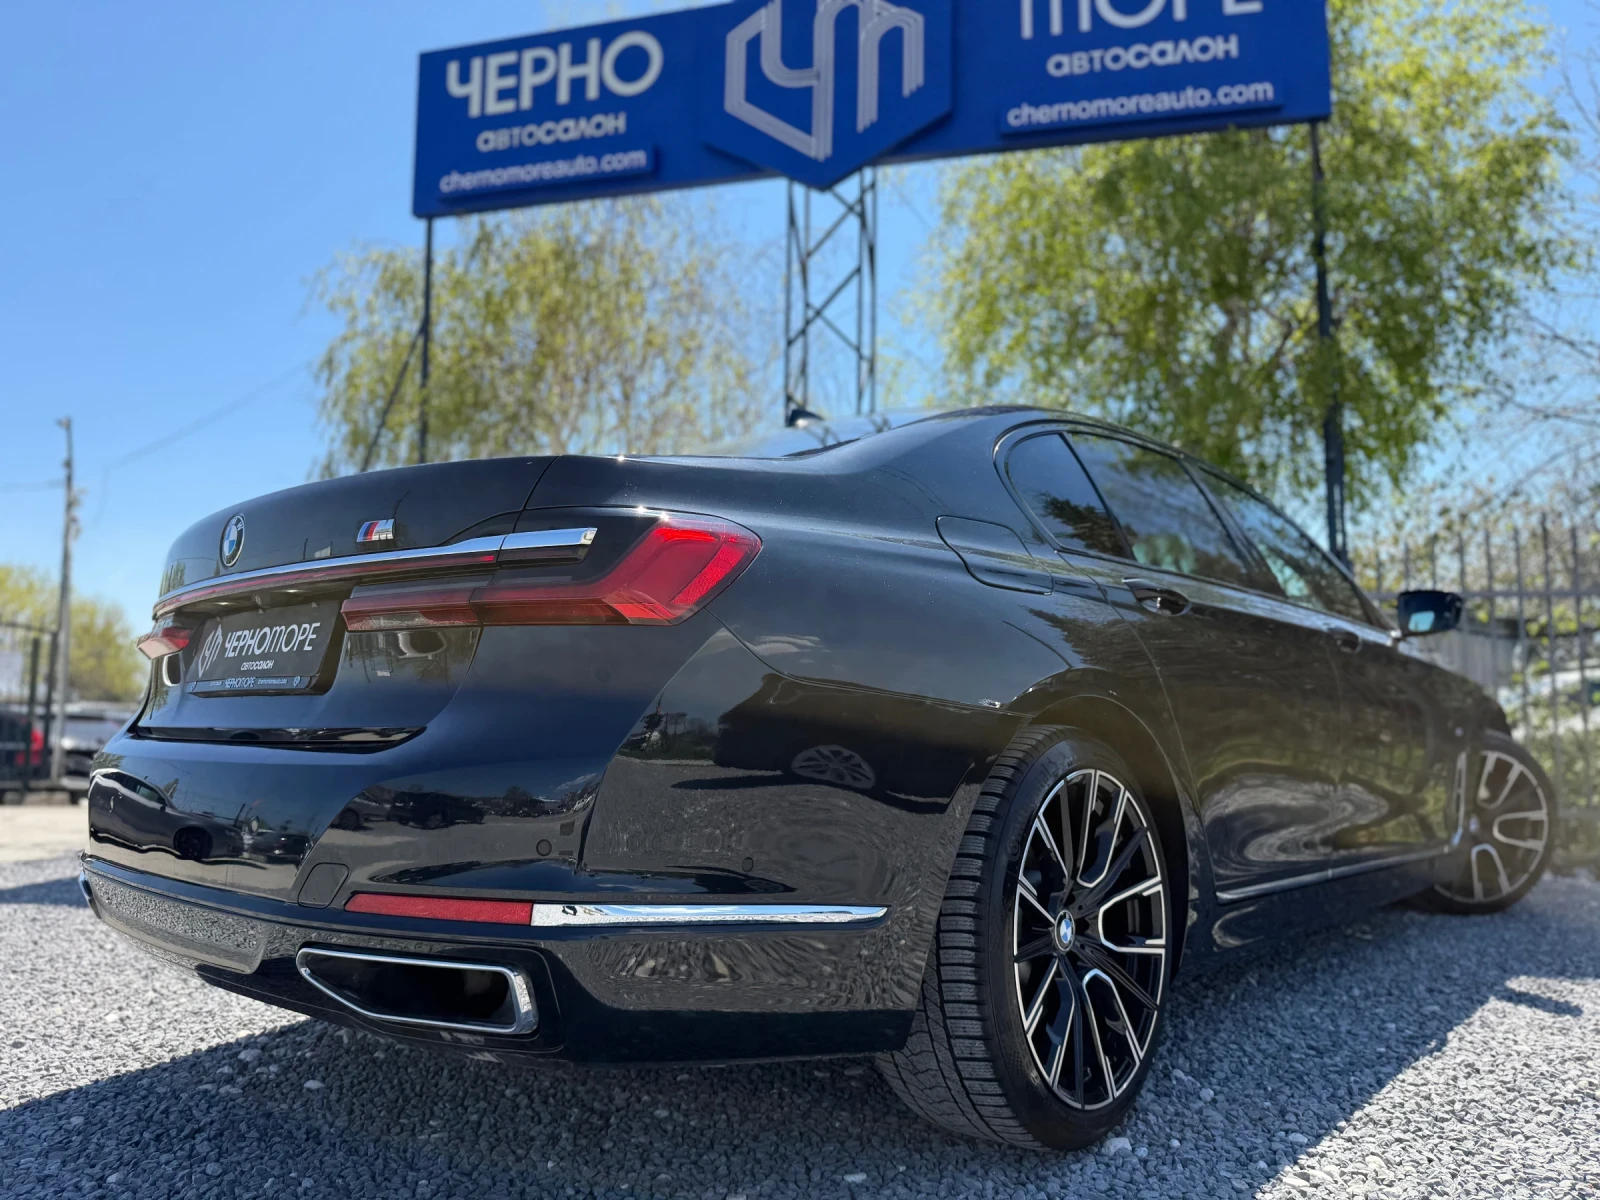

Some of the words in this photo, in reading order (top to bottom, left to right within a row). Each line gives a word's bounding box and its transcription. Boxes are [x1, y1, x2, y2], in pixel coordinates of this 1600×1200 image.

[446, 30, 664, 118] ЧЕРНО
[1046, 33, 1239, 77] автосалон
[1007, 81, 1274, 127] chernomoreauto.com
[476, 111, 627, 152] автосалон
[439, 149, 647, 193] chernomoreauto.com
[224, 622, 320, 658] ЧЕРНОМОРЕ
